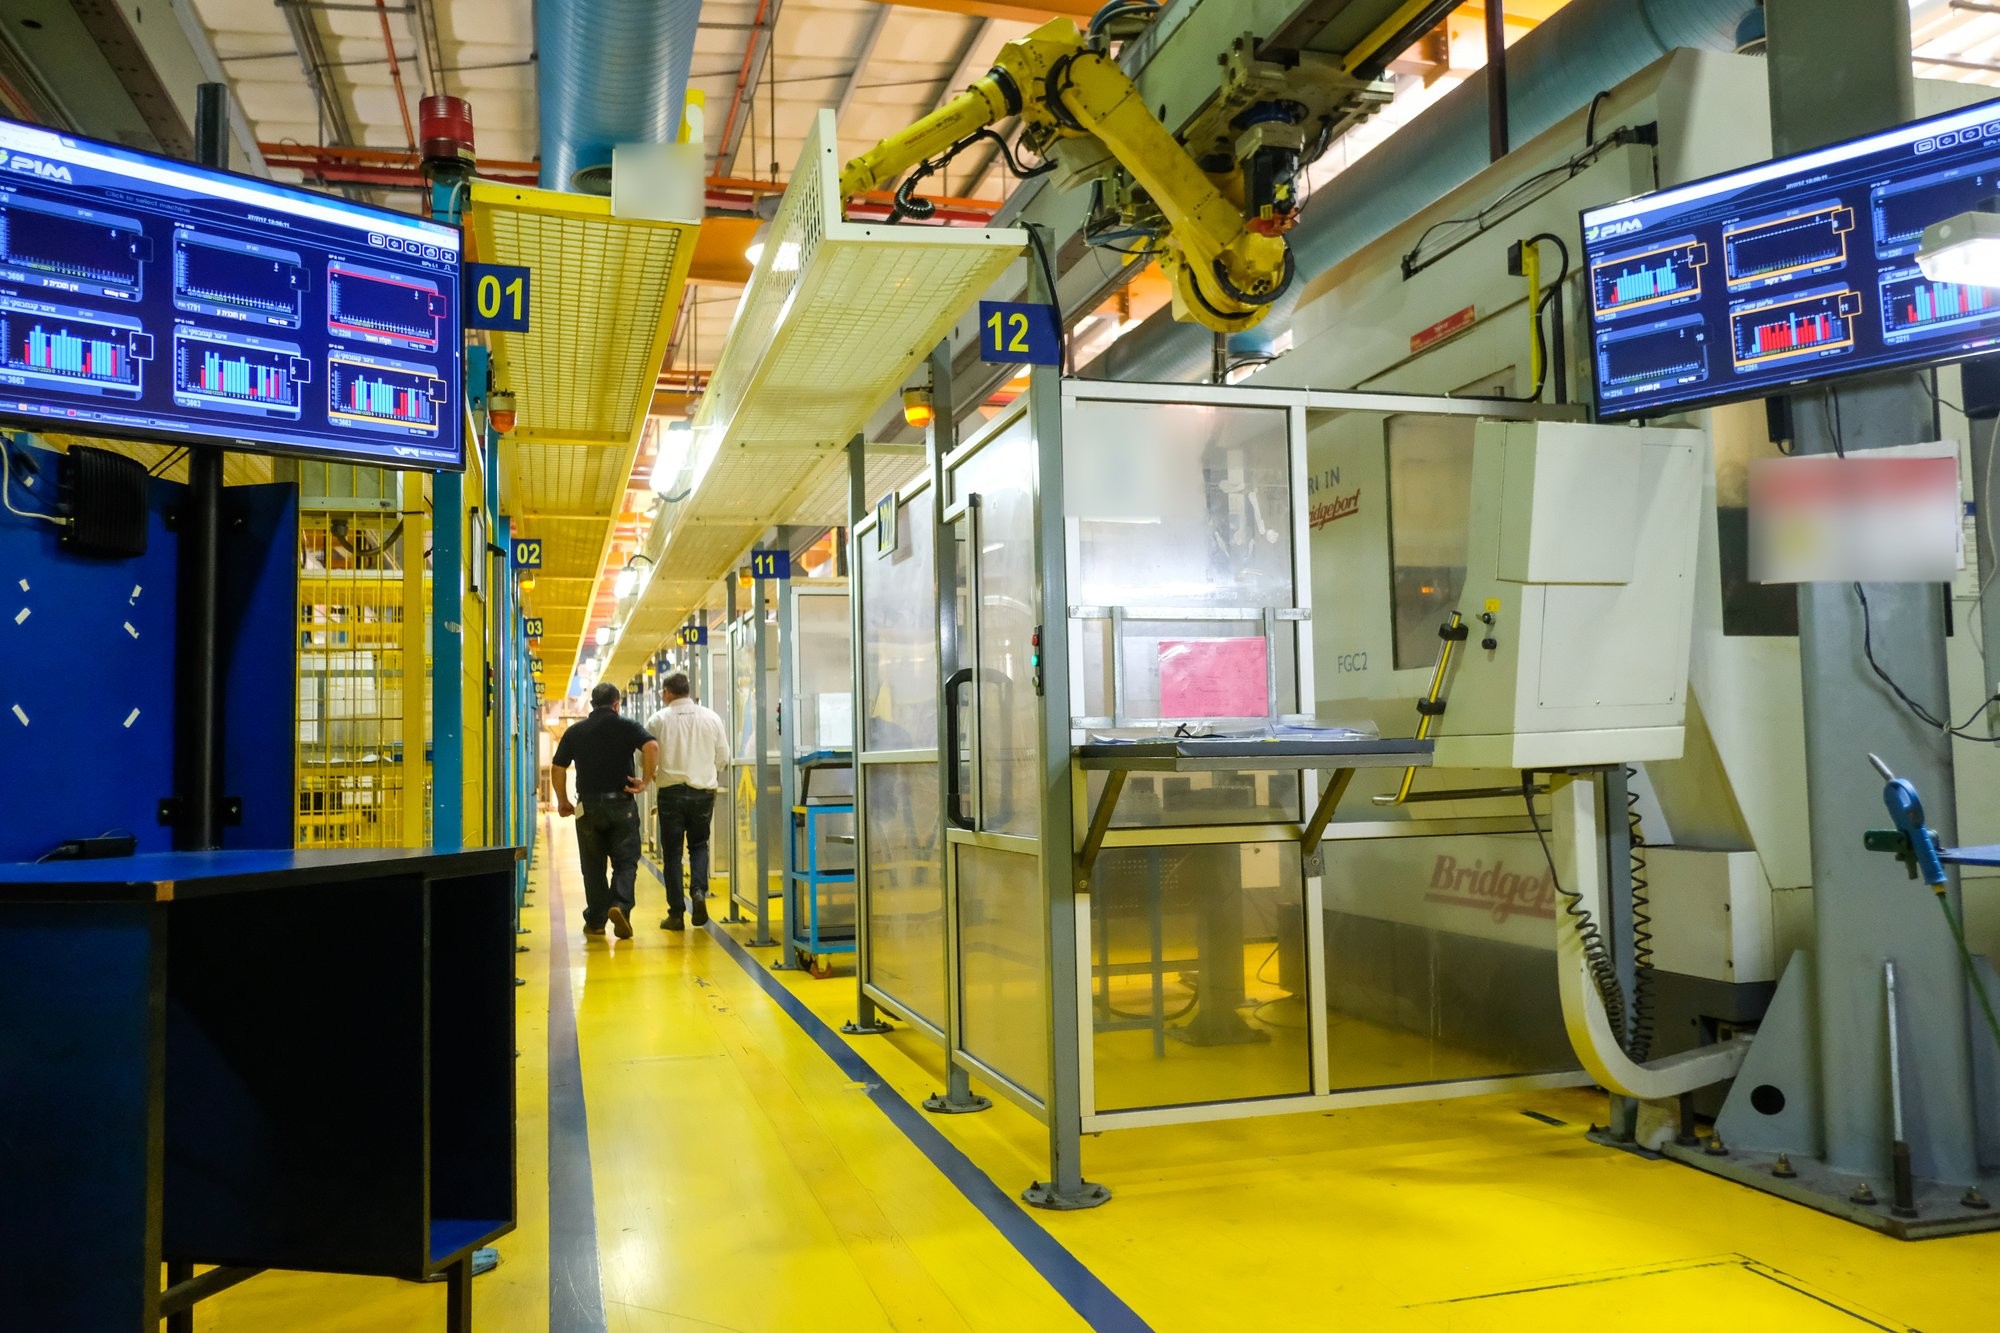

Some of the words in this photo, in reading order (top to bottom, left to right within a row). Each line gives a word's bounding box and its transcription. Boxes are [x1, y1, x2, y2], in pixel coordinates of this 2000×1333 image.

[11, 155, 72, 182] PIM
[1600, 218, 1643, 238] PIM
[131, 244, 136, 253] 1
[290, 275, 296, 284] 2
[478, 275, 523, 320] 01
[1840, 303, 1849, 311] 11
[987, 311, 1029, 352] 12
[1696, 333, 1704, 341] 10
[130, 342, 136, 351] 4
[1325, 466, 1340, 489] IN
[517, 543, 540, 564] 02
[755, 554, 775, 575] 11
[526, 620, 543, 635] 03
[684, 628, 698, 643] 10
[531, 661, 543, 672] 04
[1337, 651, 1368, 674] FGC2
[535, 683, 545, 693] 05
